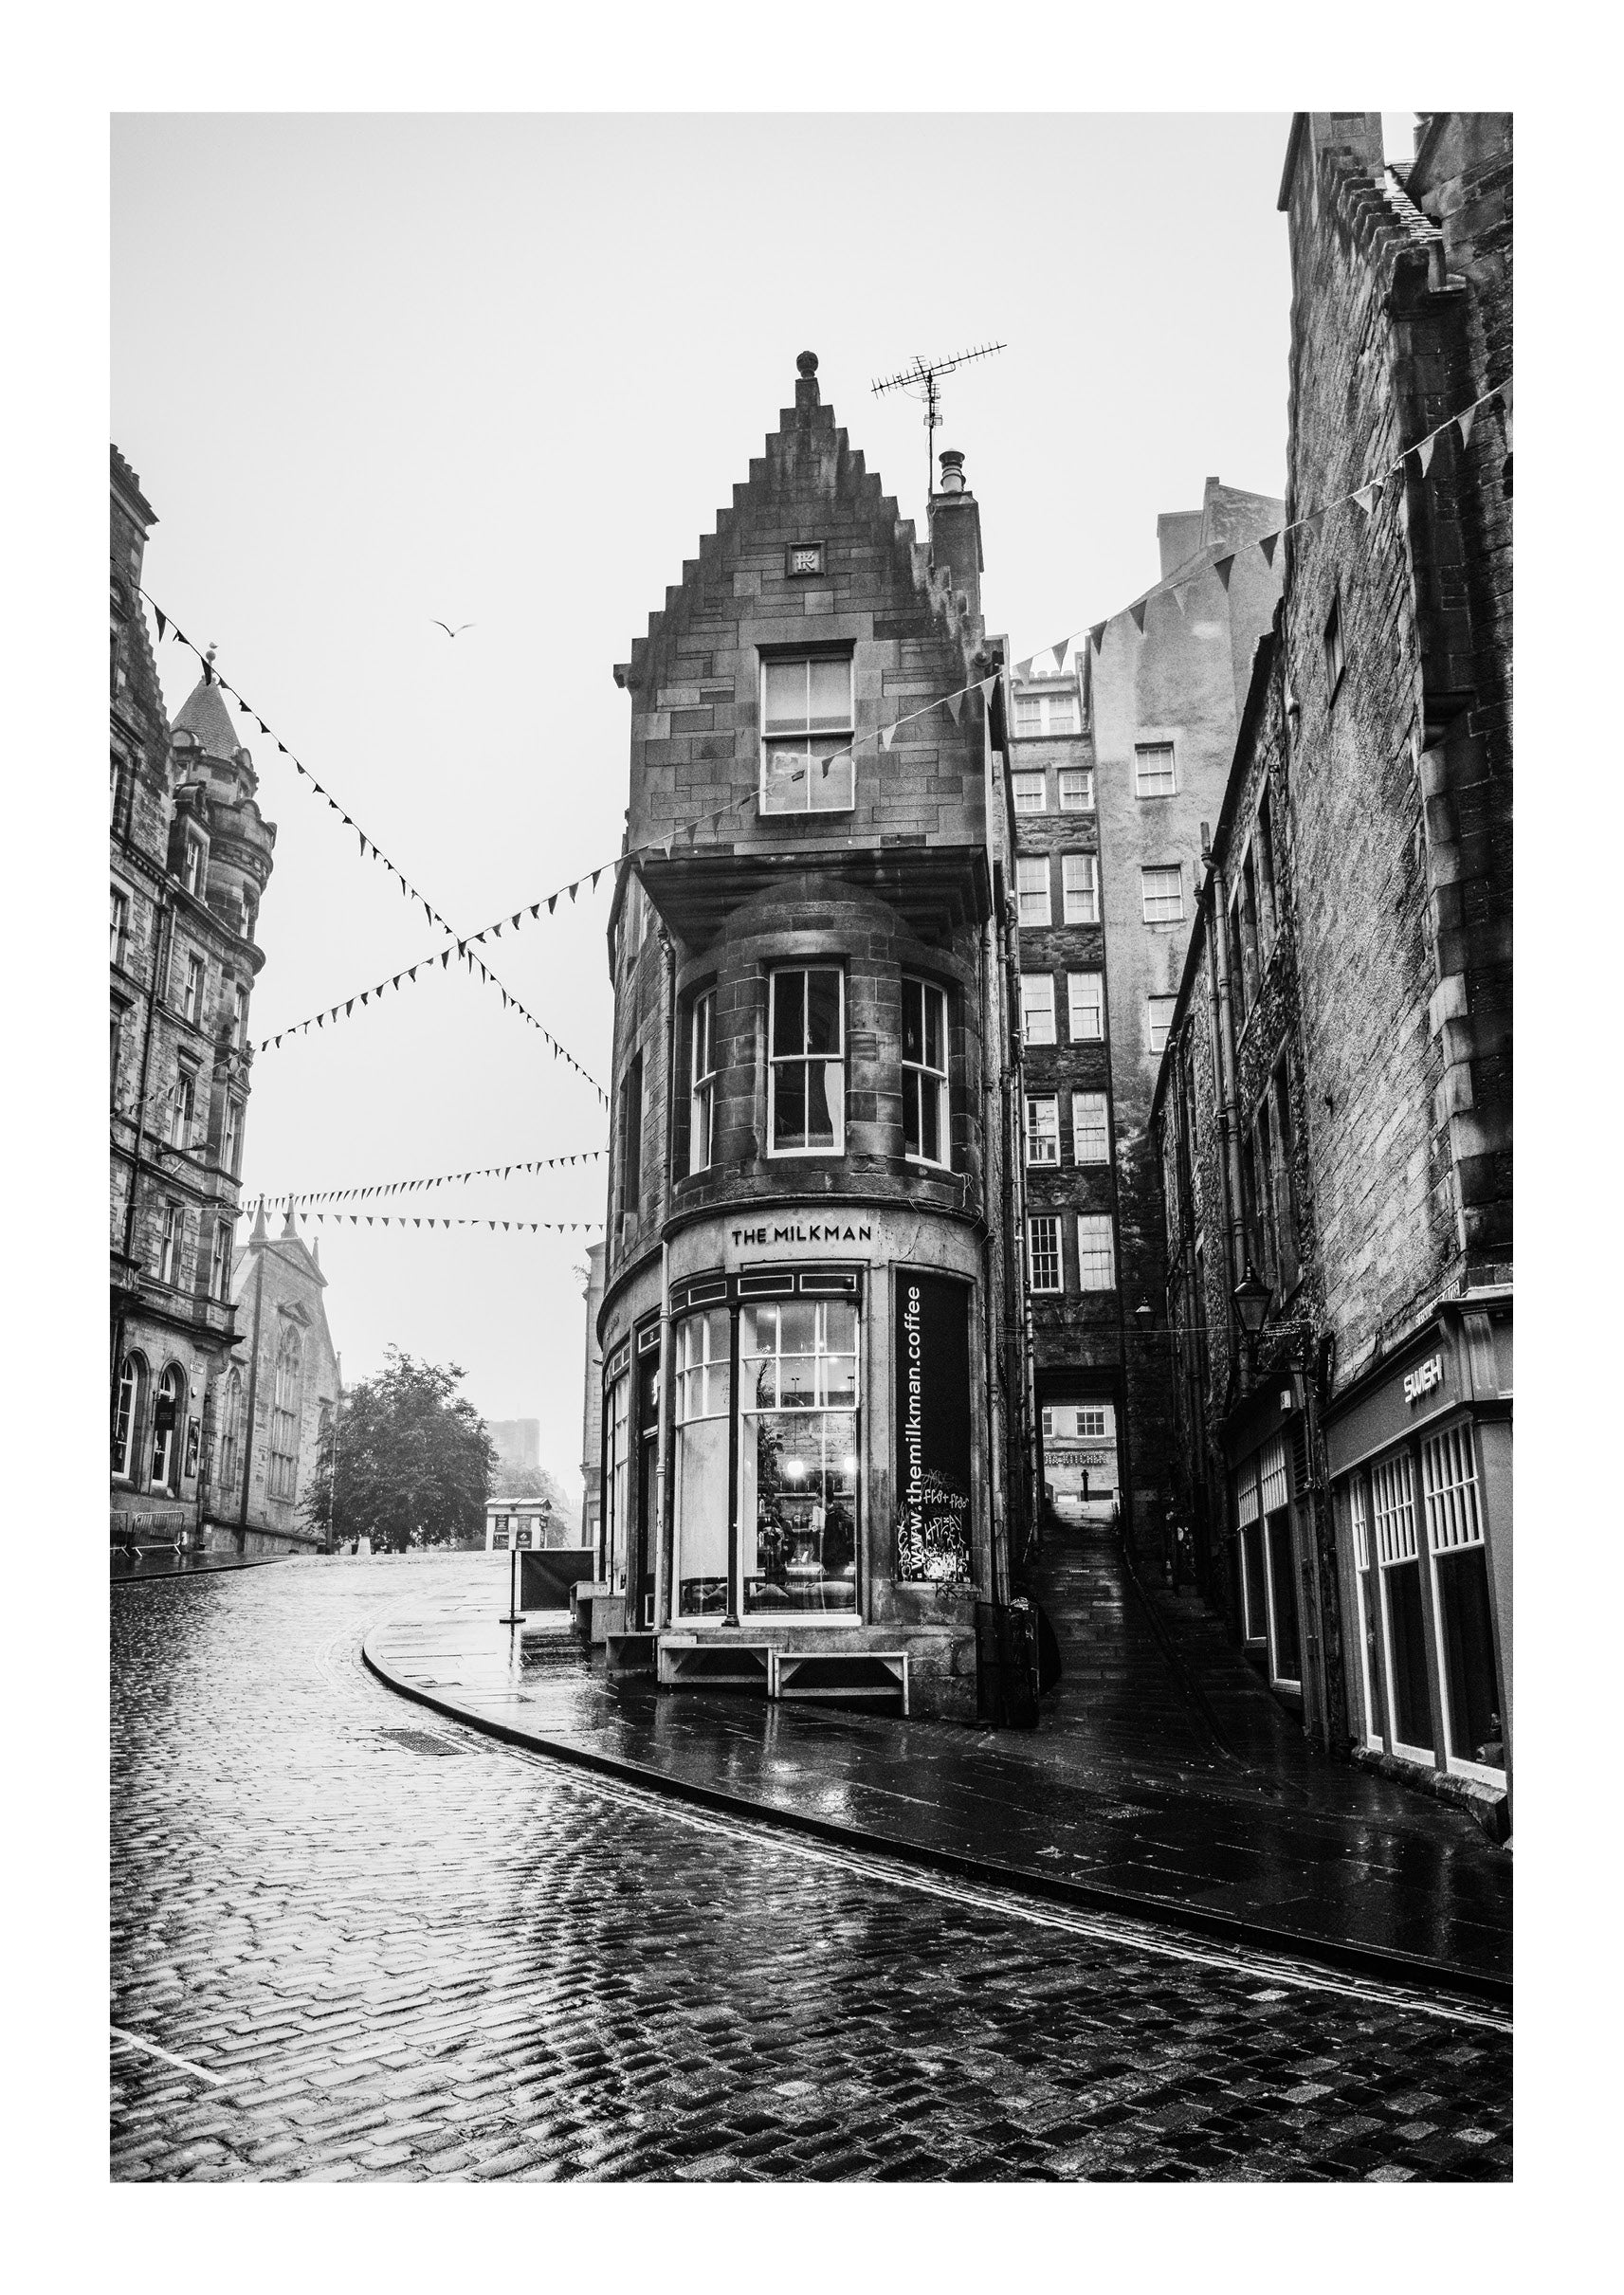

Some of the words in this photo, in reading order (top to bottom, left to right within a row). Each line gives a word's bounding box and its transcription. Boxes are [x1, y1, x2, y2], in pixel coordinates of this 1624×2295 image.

[732, 1229, 766, 1247] THE
[774, 1225, 871, 1242] MILKMAN
[1404, 1354, 1441, 1403] SWISH
[903, 1286, 923, 1570] www.themilkman.coffee
